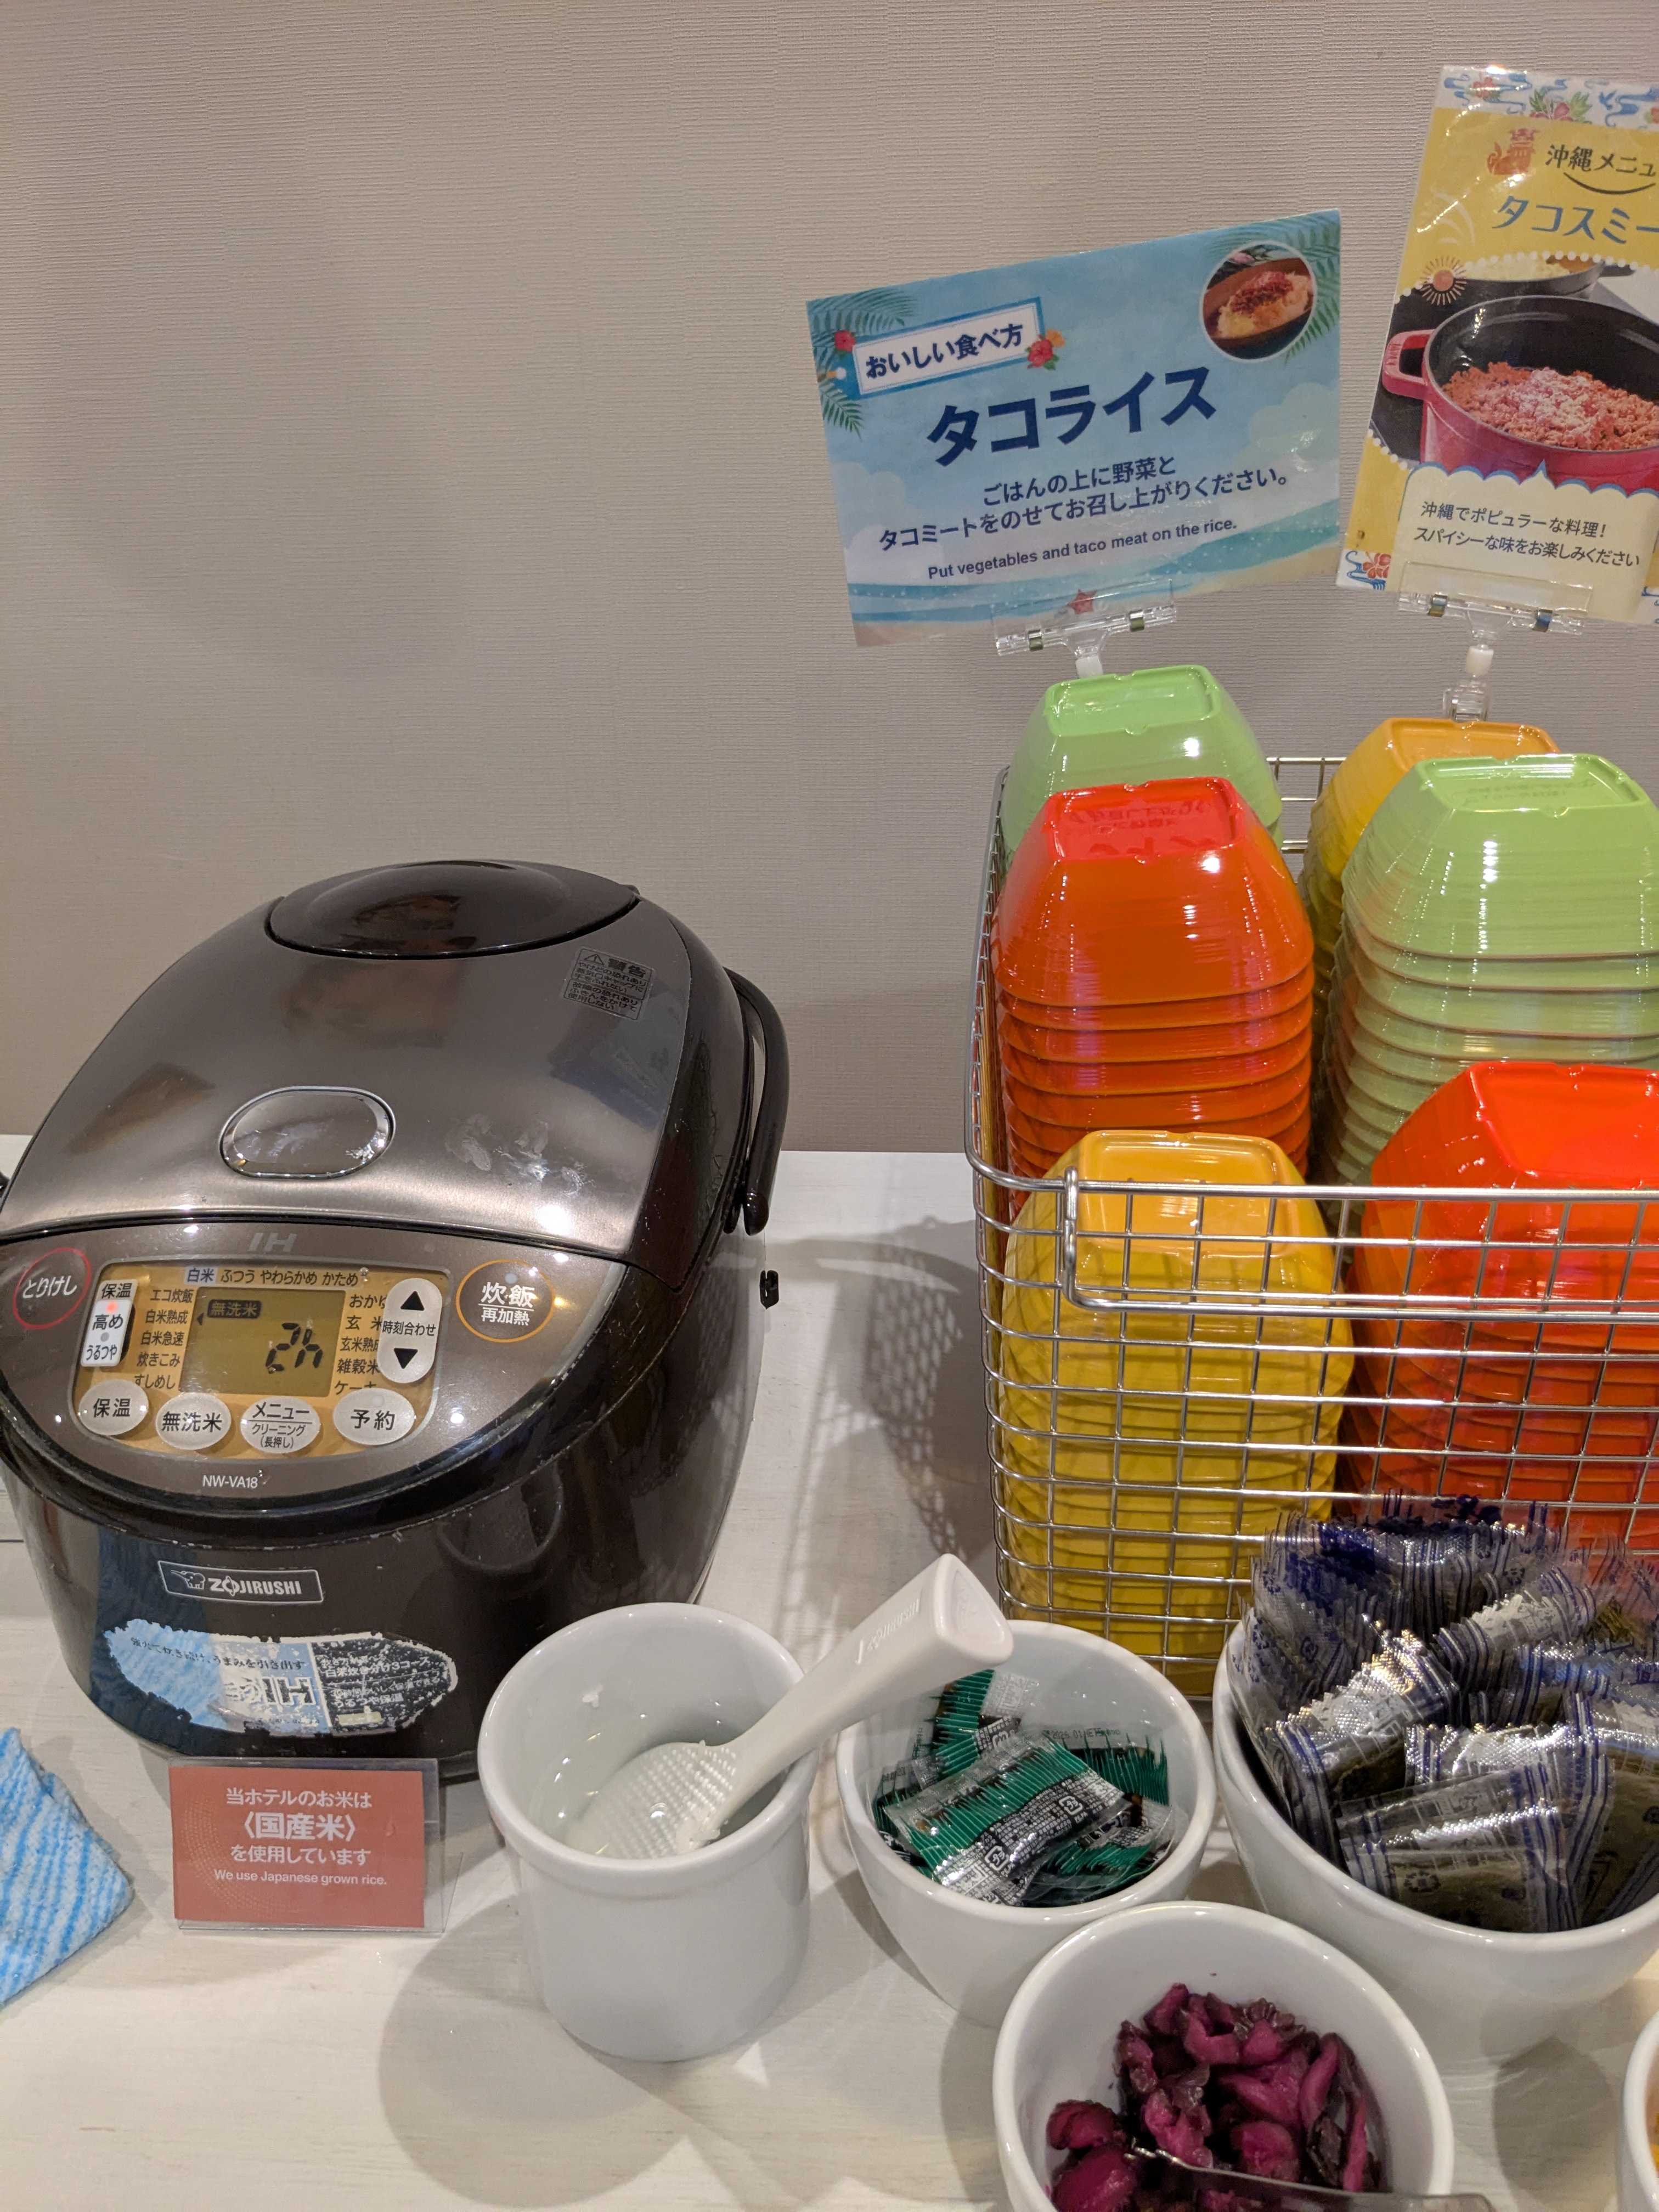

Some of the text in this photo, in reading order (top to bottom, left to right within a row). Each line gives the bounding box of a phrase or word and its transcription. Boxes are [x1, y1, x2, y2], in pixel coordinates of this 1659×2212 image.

[1545, 144, 1656, 177] 沖縄メニュ
[1492, 196, 1659, 244] タコスミー
[865, 323, 1024, 379] おいしい食べ方
[926, 366, 1216, 467] タコライス
[983, 456, 1176, 505] ごはんの上に野菜と
[879, 467, 1287, 551] タコミートをのせてお召し上がりください。
[928, 518, 1237, 579] Put vegetables and taco meat on the rice.
[1414, 527, 1639, 567] スパイシーな味をお楽しみください
[249, 1233, 297, 1252] IH
[187, 1268, 358, 1286] 白米 ふつう やわらかめ かため
[22, 1276, 78, 1300] とりけし
[101, 1283, 133, 1299] 保温
[150, 1289, 194, 1304] エコ炊飯
[481, 1281, 536, 1308] 炊飯
[145, 1309, 189, 1324] 白米熟成
[210, 1301, 258, 1317] 無洗米
[481, 1307, 530, 1326] 再加熱
[92, 1313, 123, 1330] 高め
[382, 1320, 437, 1336] 時刻合わせ
[140, 1330, 185, 1346] 白米急速
[86, 1345, 117, 1361] うるつや
[137, 1351, 180, 1368] 炊きこみ
[337, 1358, 381, 1375] 雑穀米
[134, 1373, 176, 1389] すしめし
[93, 1398, 131, 1419] 保温
[252, 1401, 310, 1419] メニュー
[162, 1412, 223, 1432] 無洗米
[252, 1423, 306, 1436] クリーニング
[350, 1409, 396, 1431] 予約
[202, 1474, 259, 1489] NW-VA18
[208, 1575, 302, 1597] ZOJIRUSHI
[226, 1787, 373, 1809] 当ホテルのお米は
[230, 1843, 371, 1866] を使用しています
[214, 1869, 387, 1886] We use Japanese grown rice.
